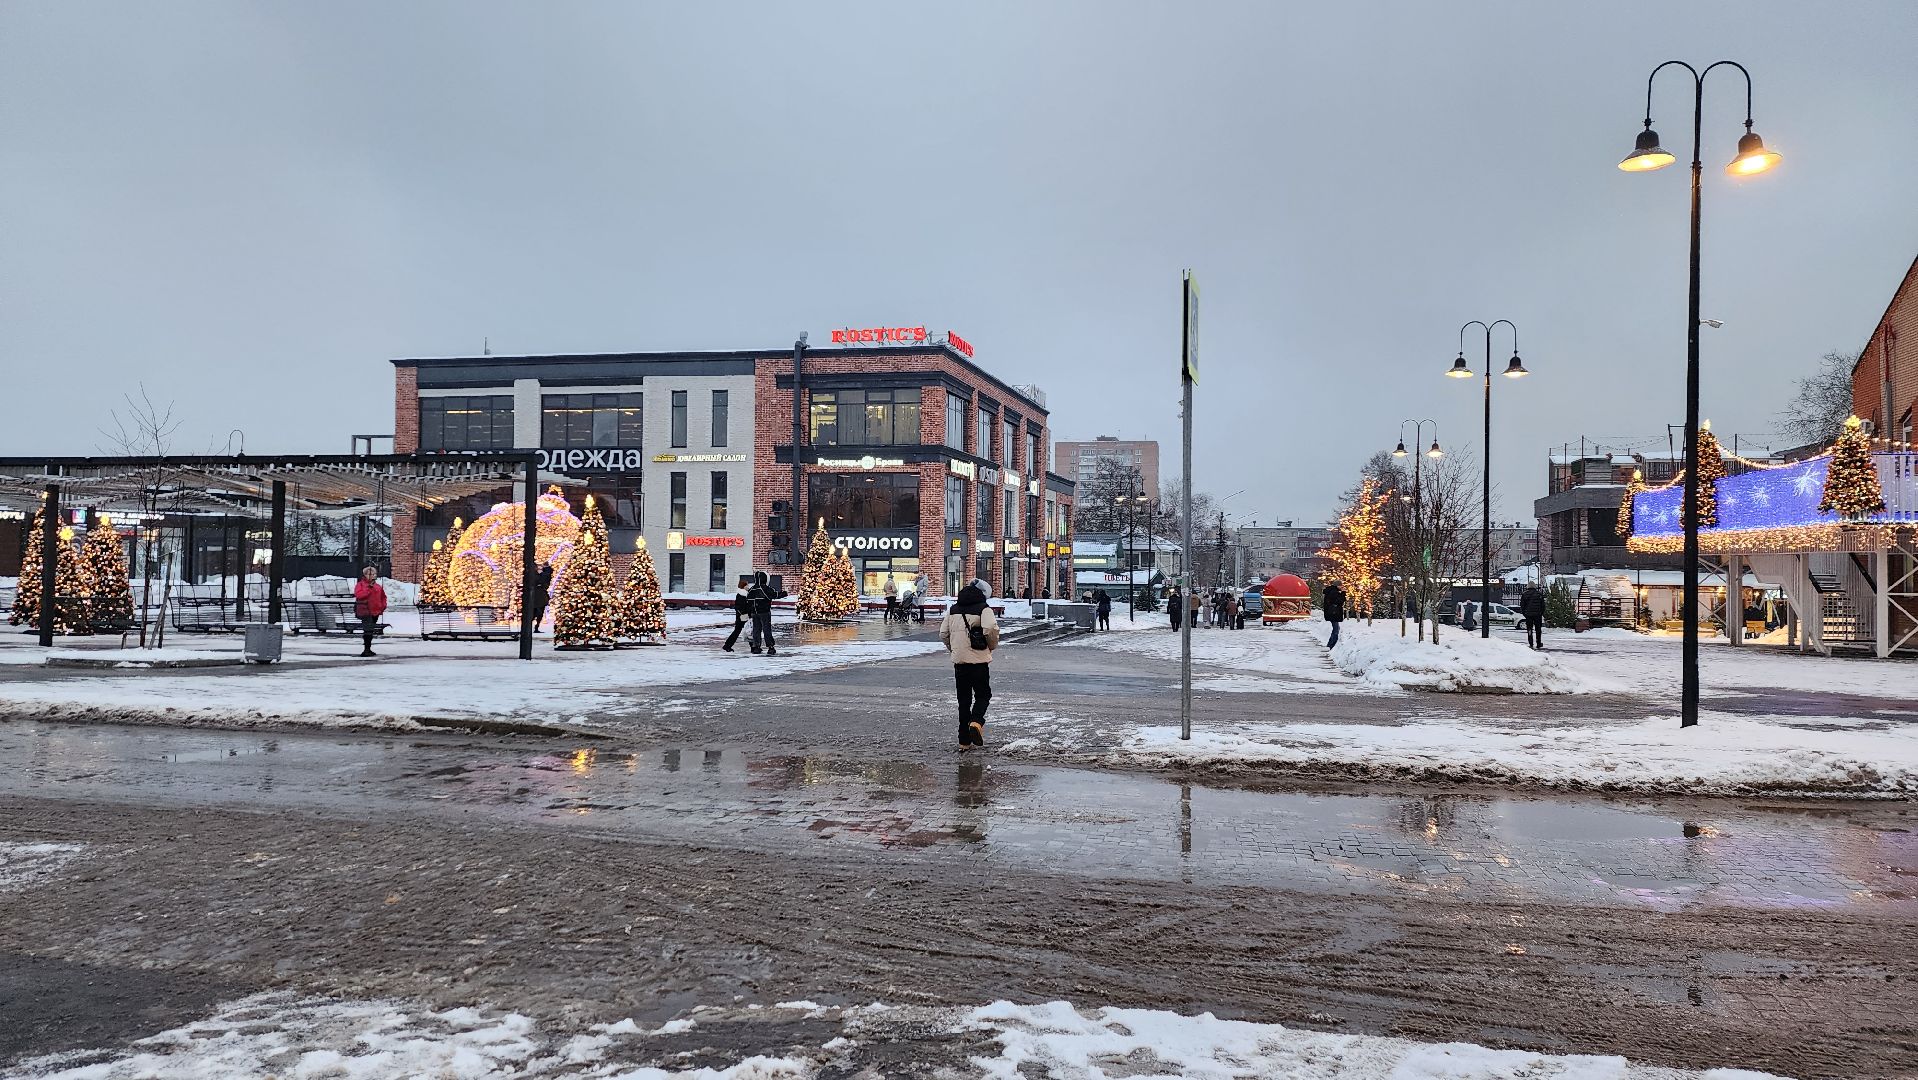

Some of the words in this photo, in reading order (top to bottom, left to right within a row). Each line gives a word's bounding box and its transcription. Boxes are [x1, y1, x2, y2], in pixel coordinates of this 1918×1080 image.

[831, 327, 927, 343] ROSTIC'S
[534, 449, 641, 471] одежда
[677, 453, 722, 462] ЮВЕЛИРНЫЙ
[722, 454, 747, 462] САЛОН
[685, 536, 745, 548] ROSTIC'S
[834, 536, 913, 550] СТОЛОТО
